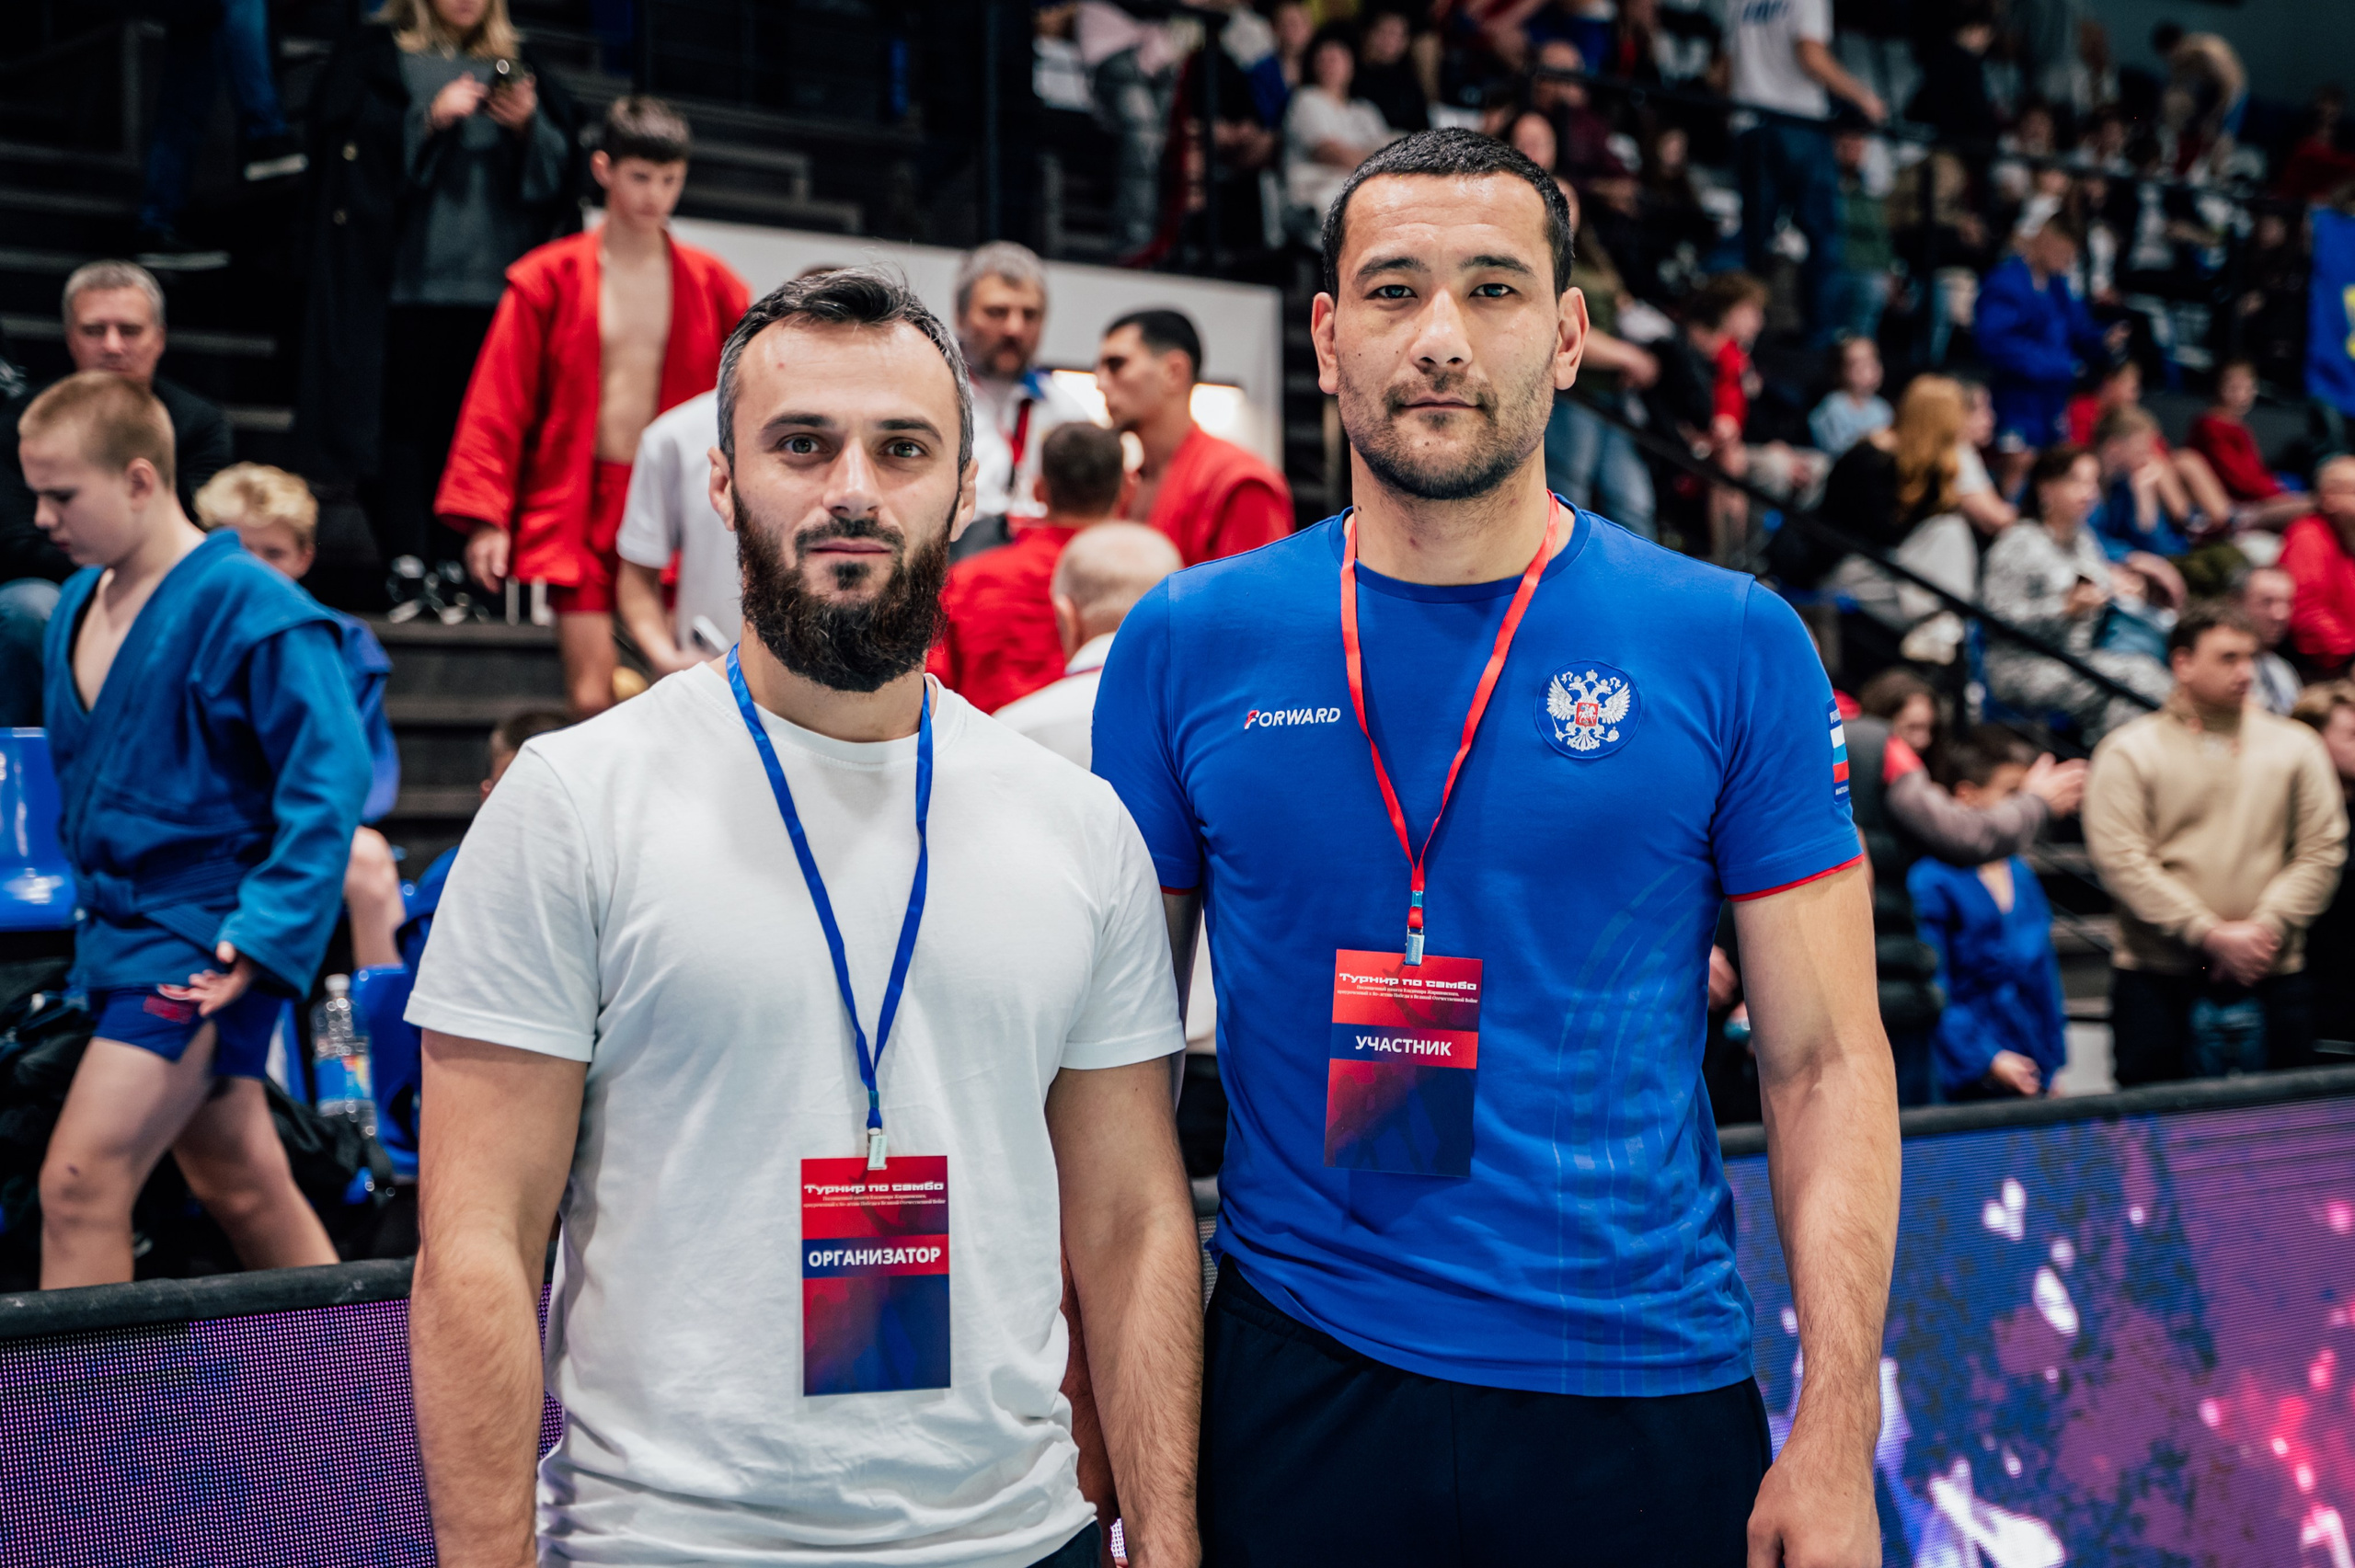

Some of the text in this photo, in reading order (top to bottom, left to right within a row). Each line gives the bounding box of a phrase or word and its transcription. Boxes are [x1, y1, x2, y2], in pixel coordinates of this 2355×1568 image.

[1244, 707, 1341, 730] FORWARD
[1338, 973, 1477, 990] Турнир по самбо
[1355, 1036, 1453, 1057] УЧАСТНИК
[804, 1181, 945, 1196] Турнир по самбо
[808, 1246, 942, 1267] ОРГАНИЗАТОР
